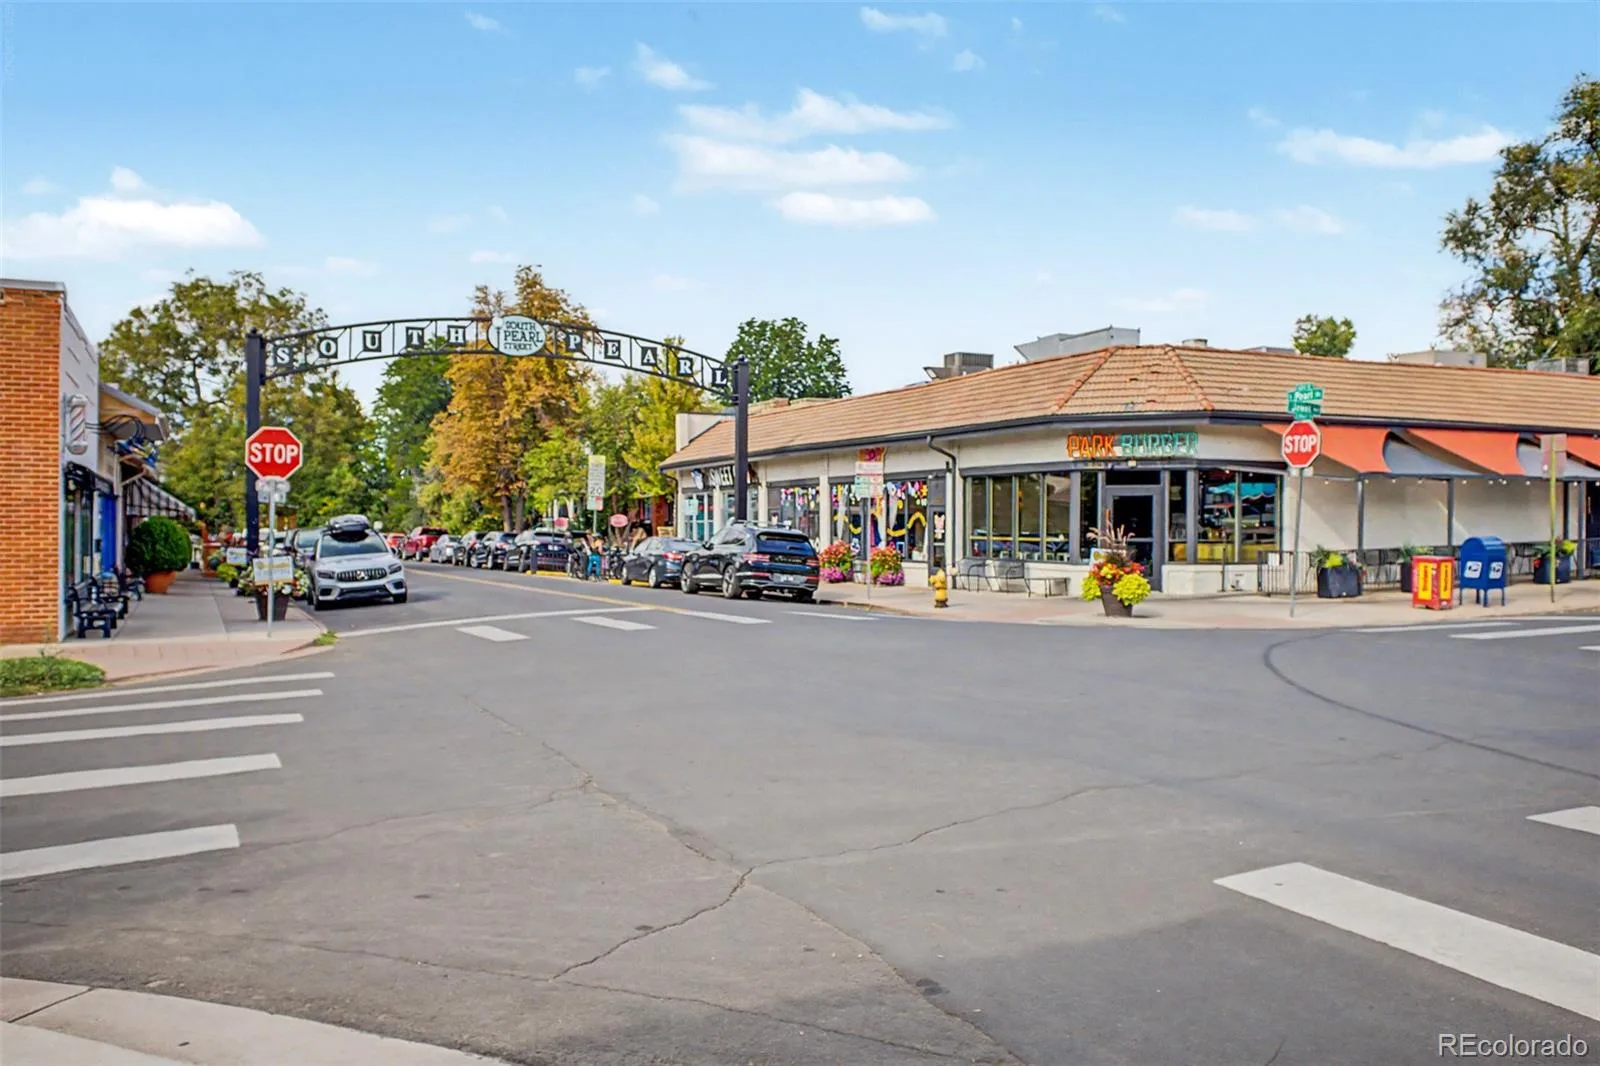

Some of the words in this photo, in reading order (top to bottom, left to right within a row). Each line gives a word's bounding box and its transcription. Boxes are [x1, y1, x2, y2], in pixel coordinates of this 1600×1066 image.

[505, 320, 536, 331] SOUTH
[503, 330, 543, 347] PEARL
[503, 342, 532, 351] STREET
[275, 325, 466, 365] SOUTH
[568, 332, 728, 386] PEARL
[250, 442, 298, 464] STOP
[1067, 432, 1116, 458] PARK
[1121, 432, 1198, 457] BURGER
[1284, 434, 1316, 454] STOP
